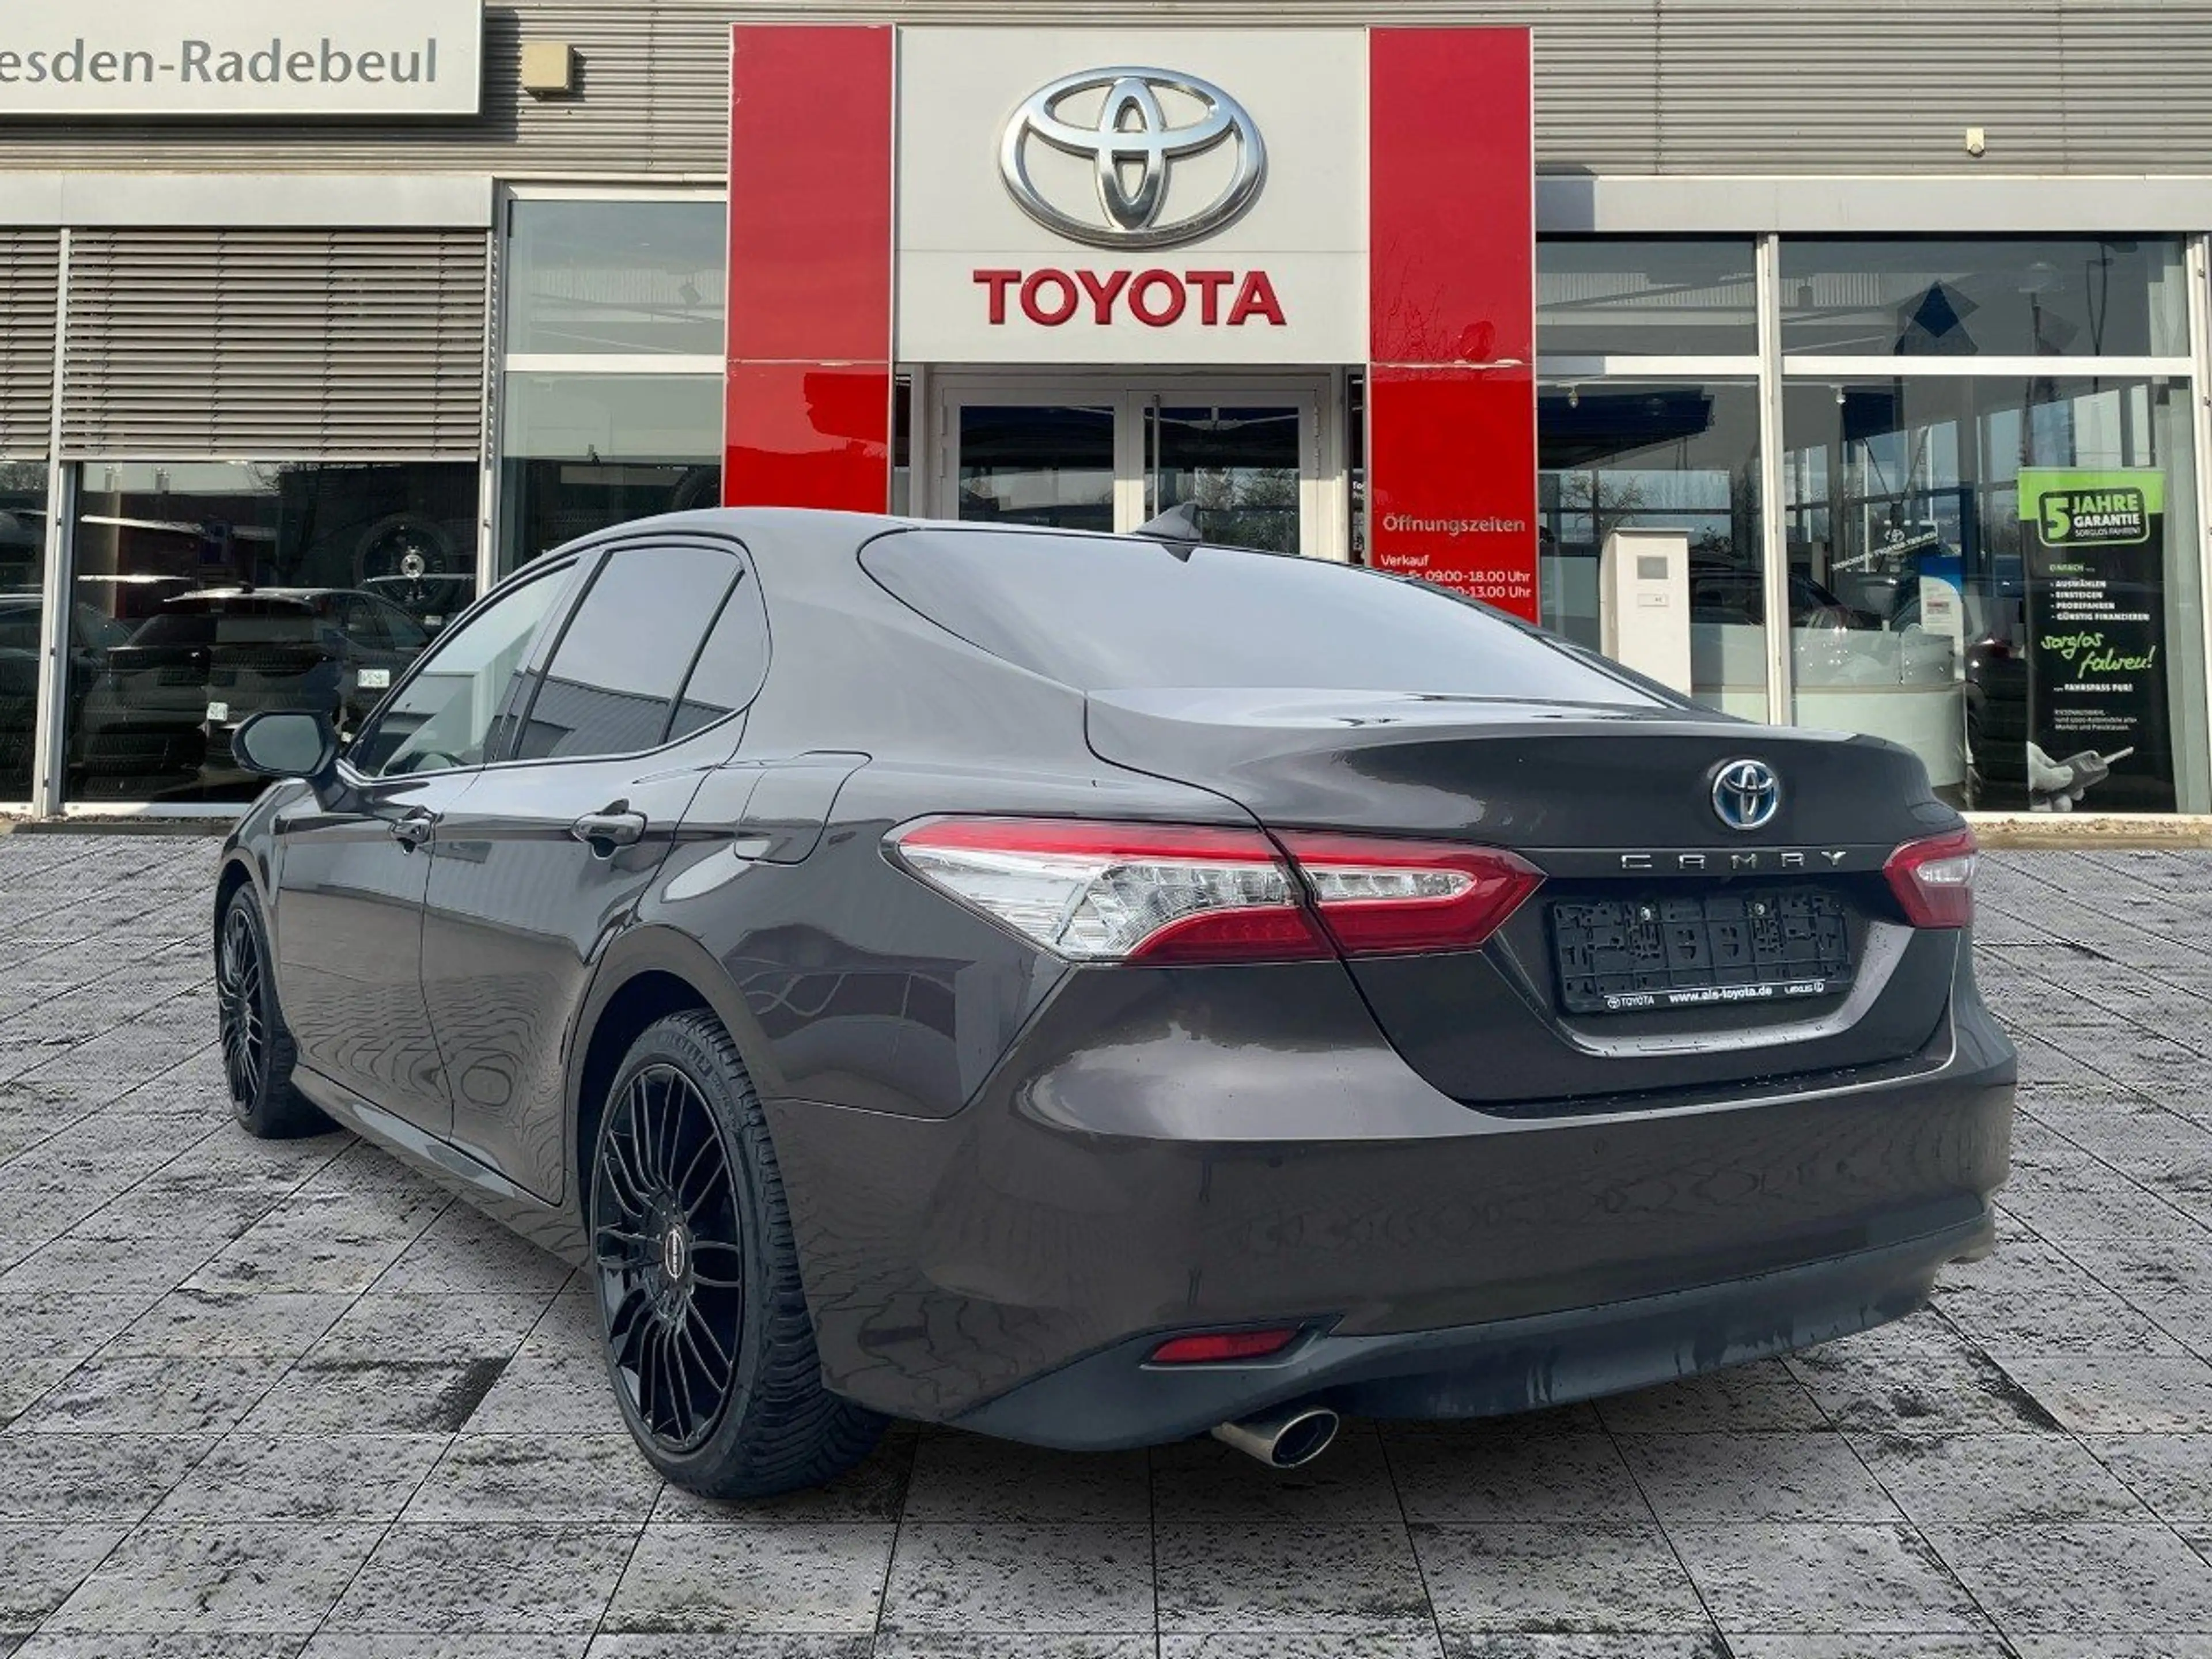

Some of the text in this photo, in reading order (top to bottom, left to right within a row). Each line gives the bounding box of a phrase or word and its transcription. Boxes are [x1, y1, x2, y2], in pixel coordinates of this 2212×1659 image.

[973, 268, 1287, 327] TOYOTA
[1382, 512, 1525, 536] Öffnungszeiten
[2046, 494, 2138, 539] 5 JAHRE
[2073, 513, 2141, 528] GARANTIE
[1380, 555, 1430, 566] Verkauf
[1508, 570, 1531, 582] Uhr
[1509, 586, 1531, 597] Uhr
[2040, 631, 2104, 659] sorglos
[1620, 851, 1846, 869] CAMRY
[1621, 995, 1654, 1006] TOYOTA
